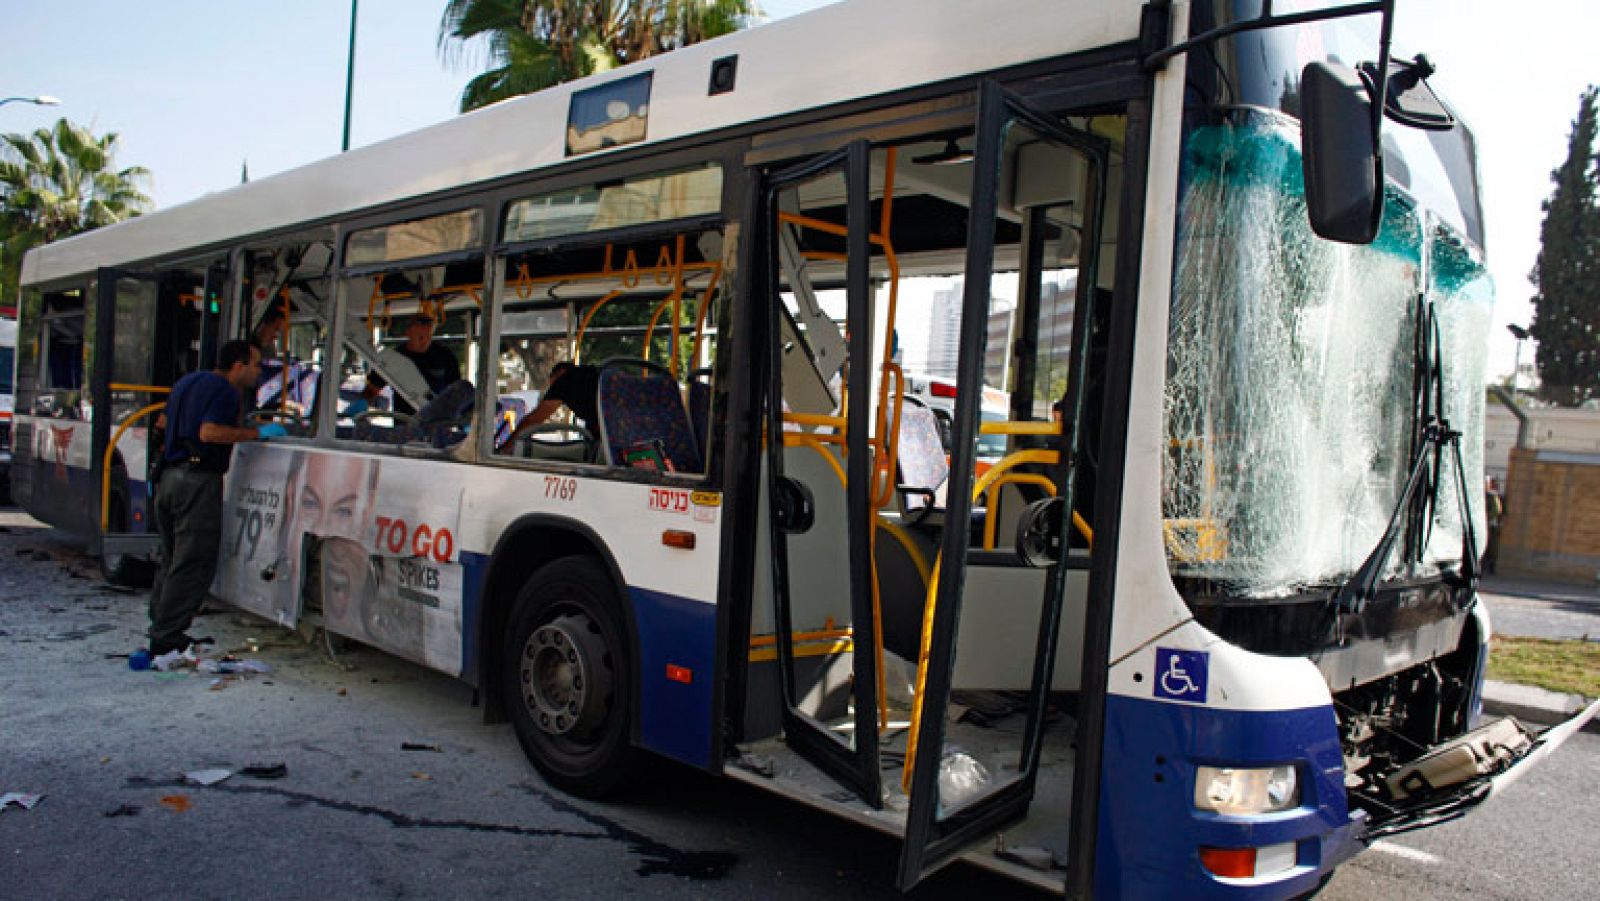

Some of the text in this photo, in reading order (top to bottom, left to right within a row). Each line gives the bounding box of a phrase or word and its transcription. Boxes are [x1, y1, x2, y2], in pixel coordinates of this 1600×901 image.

[544, 475, 577, 501] 7769
[650, 488, 688, 511] כניסה
[375, 515, 453, 563] TO GO
[399, 558, 440, 590] SPIKES
